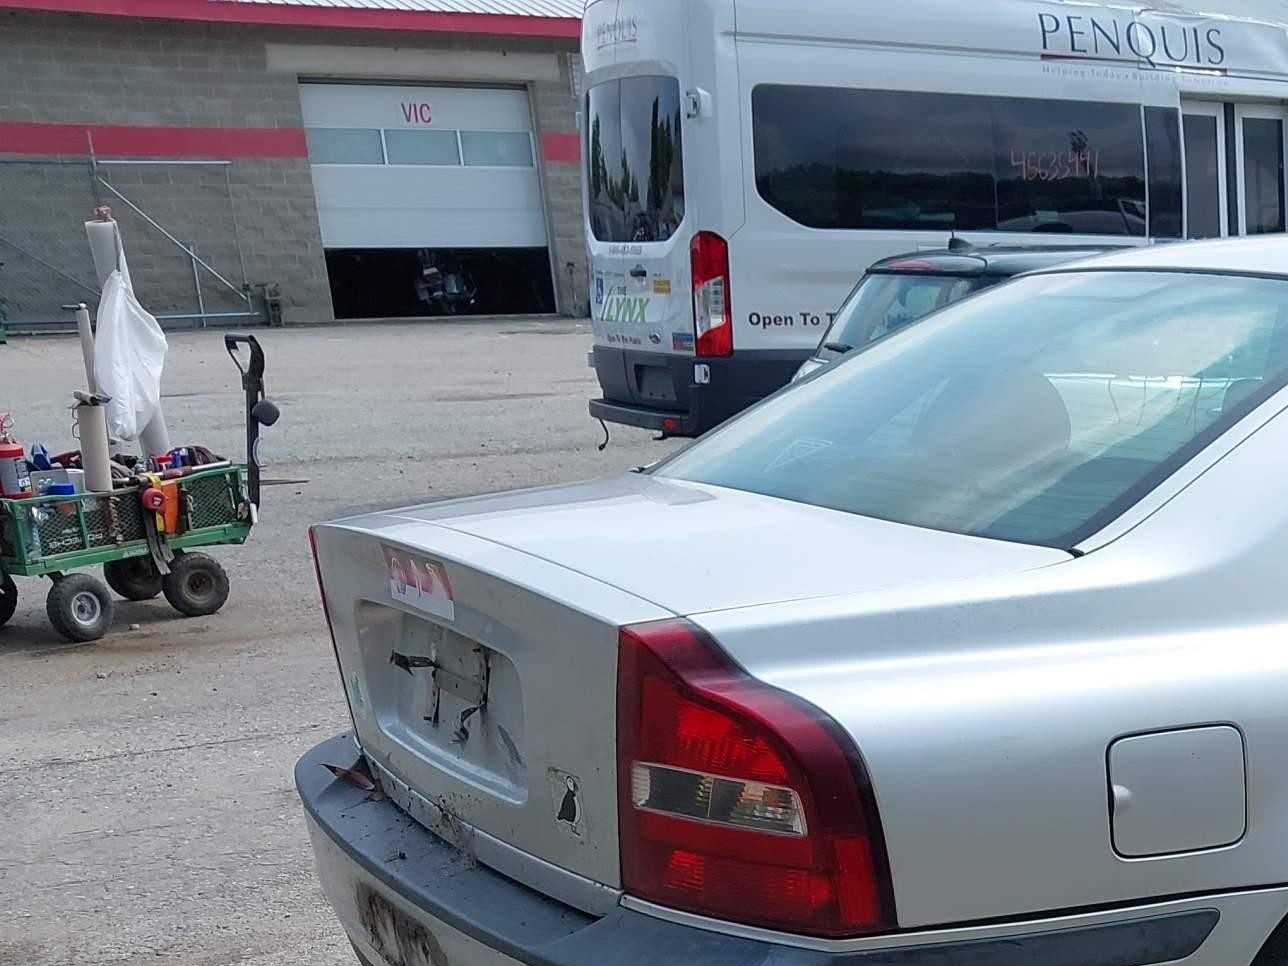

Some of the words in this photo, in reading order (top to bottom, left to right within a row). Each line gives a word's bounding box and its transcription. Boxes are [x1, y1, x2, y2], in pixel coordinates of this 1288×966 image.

[1038, 13, 1225, 68] PENQUIS
[400, 102, 432, 124] VIC
[606, 297, 650, 323] LYNX
[748, 312, 794, 330] Open
[800, 312, 820, 326] To
